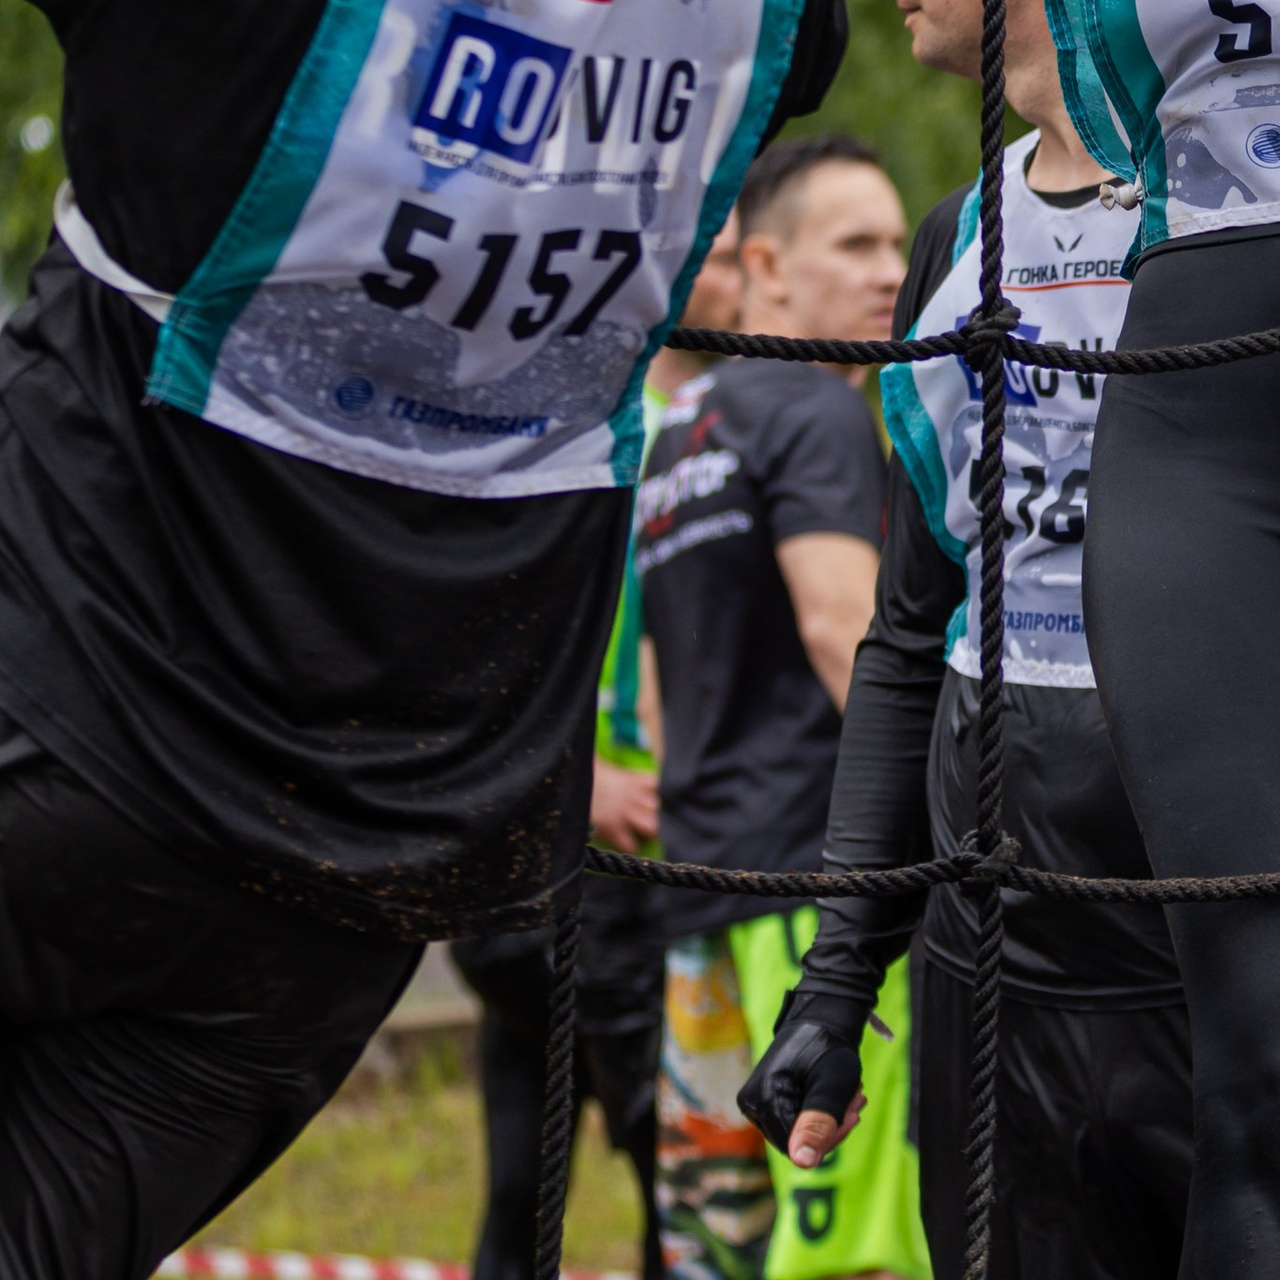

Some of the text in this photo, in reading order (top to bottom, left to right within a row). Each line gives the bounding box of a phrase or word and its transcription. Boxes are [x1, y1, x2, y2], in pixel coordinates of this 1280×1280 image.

[428, 34, 698, 145] ROVIG
[359, 200, 643, 342] 5157
[1007, 259, 1122, 285] ГОНКА ГЕРОЕ
